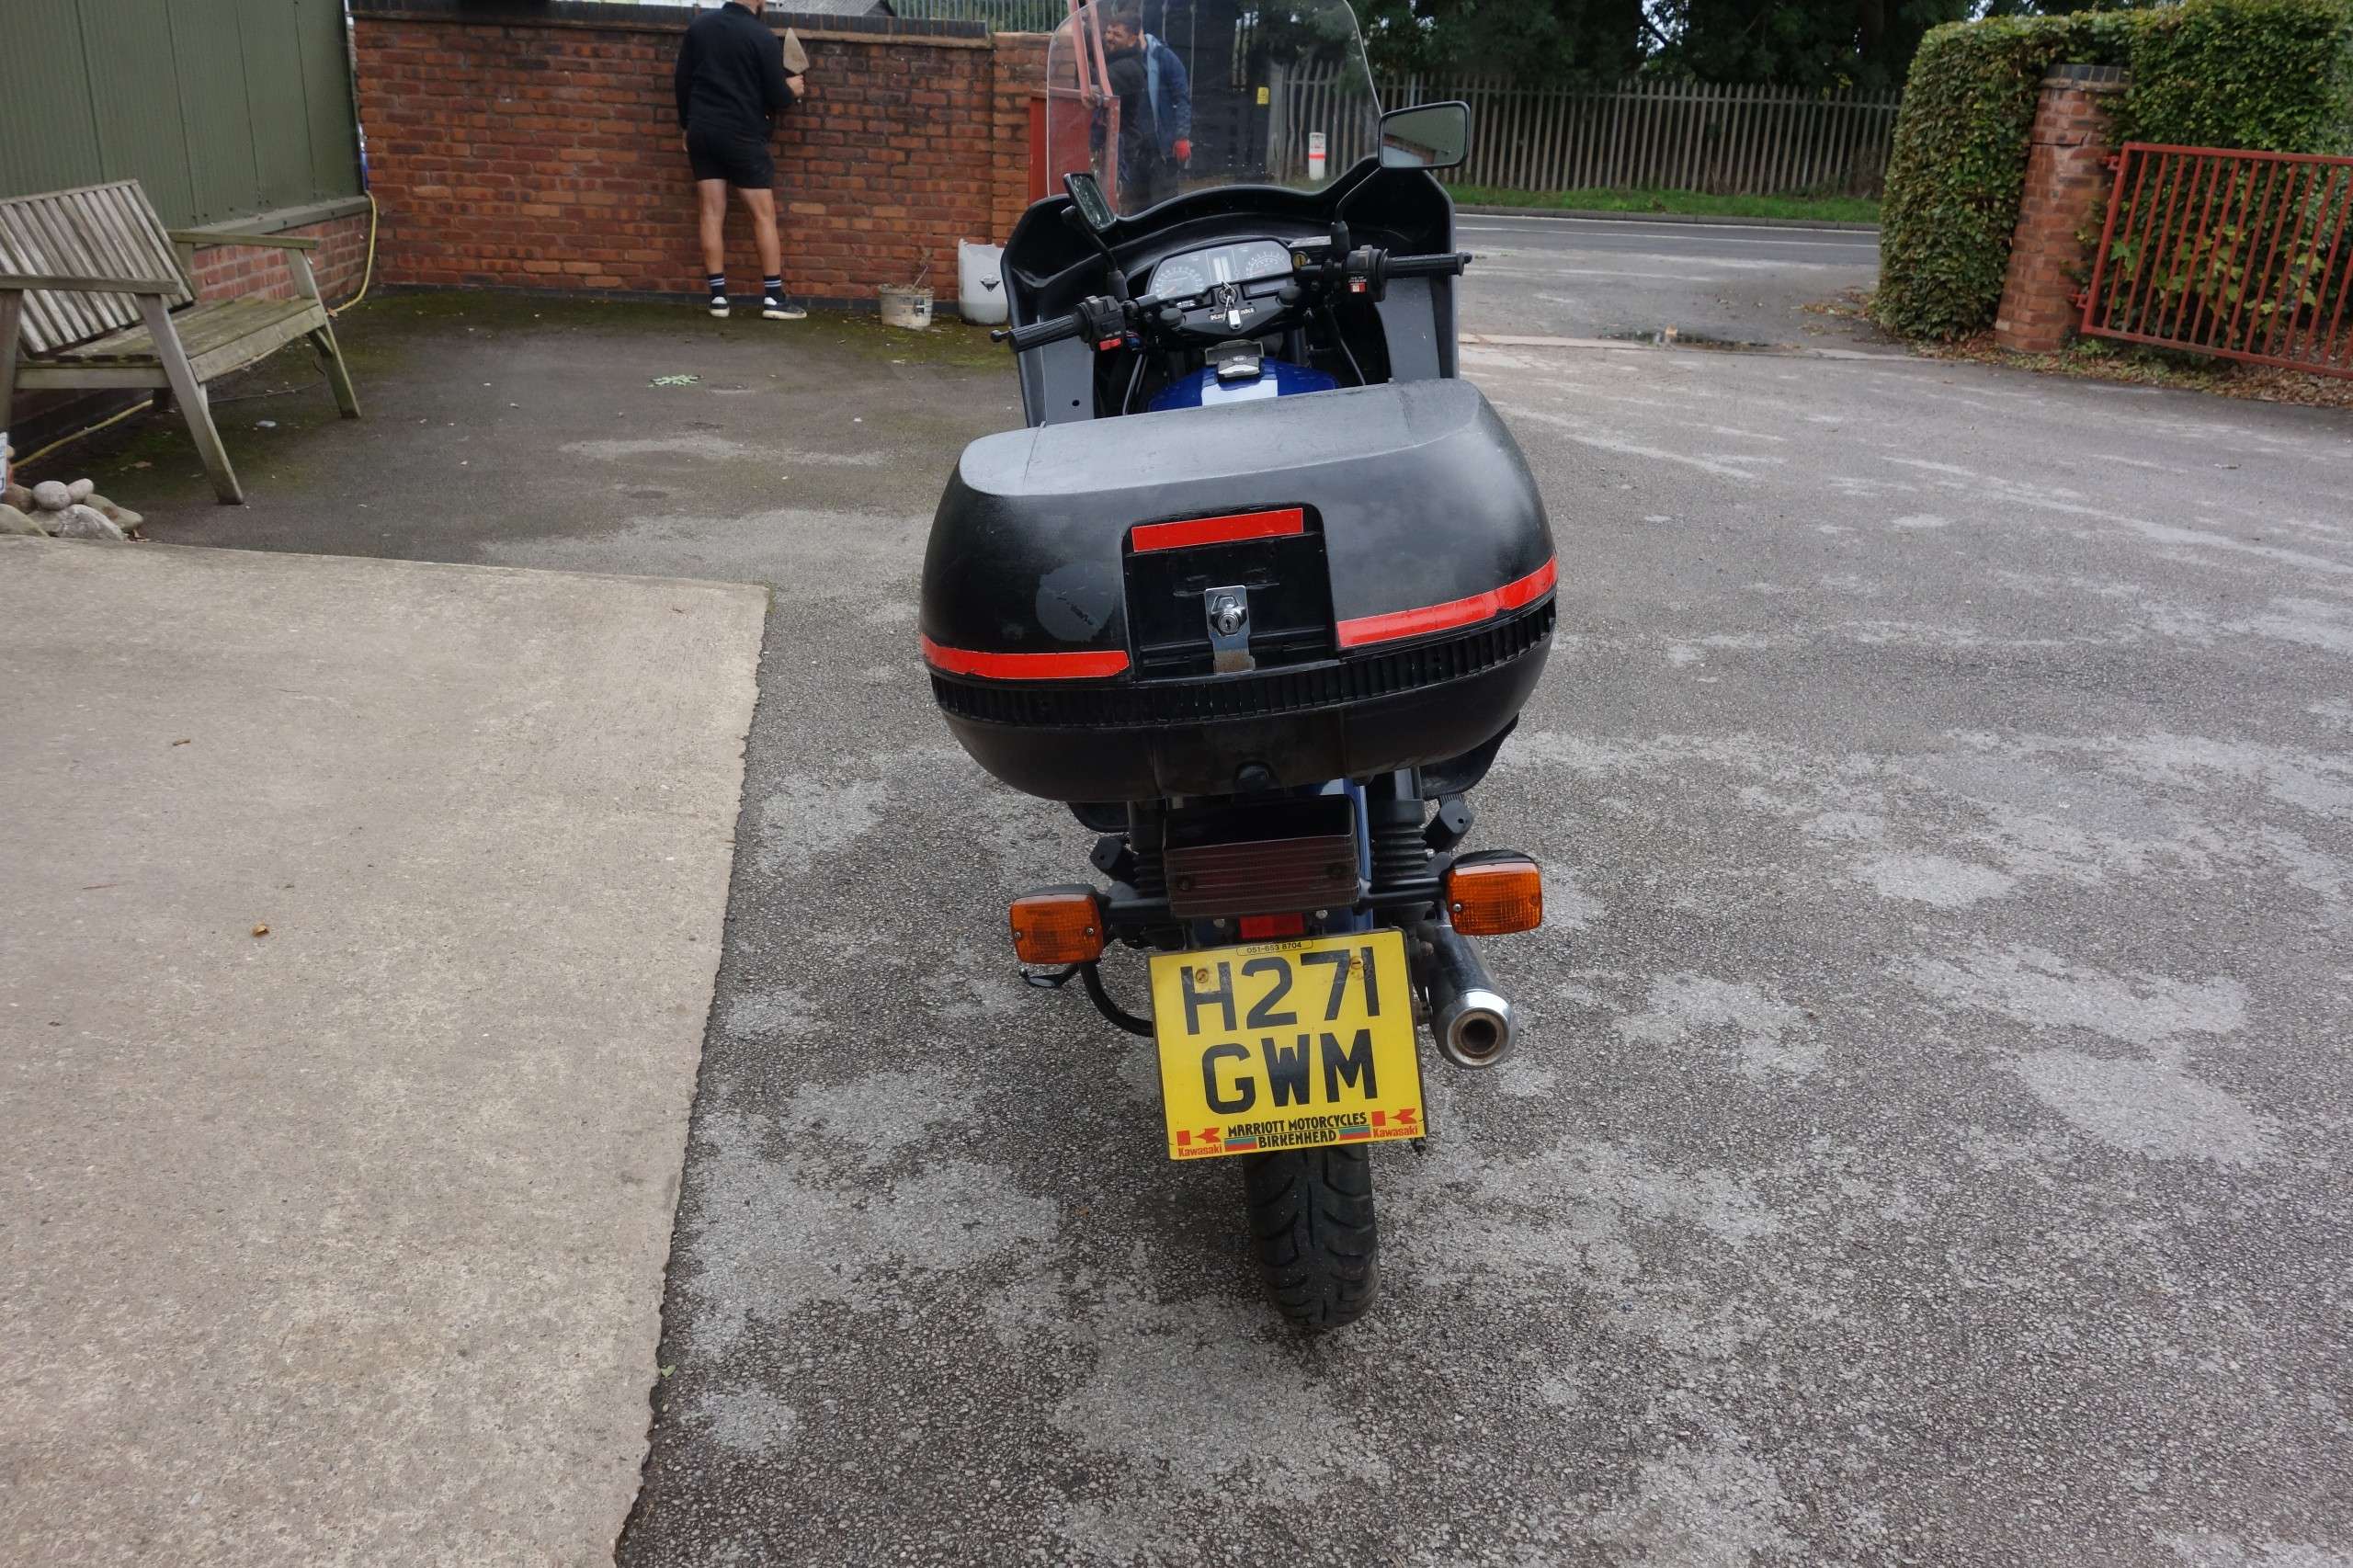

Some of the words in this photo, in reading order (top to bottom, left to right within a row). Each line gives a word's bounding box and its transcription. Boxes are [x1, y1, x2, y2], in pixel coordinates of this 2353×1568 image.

[1180, 946, 1381, 1035] H271
[1201, 1028, 1378, 1115] GWM
[1228, 1119, 1286, 1138] MARRIOTT
[1289, 1111, 1368, 1131] MOTORCYCLES
[1373, 1125, 1418, 1139] Kawasaki
[1177, 1144, 1222, 1157] Kawasaki
[1258, 1130, 1337, 1149] BIRKENHEAD
